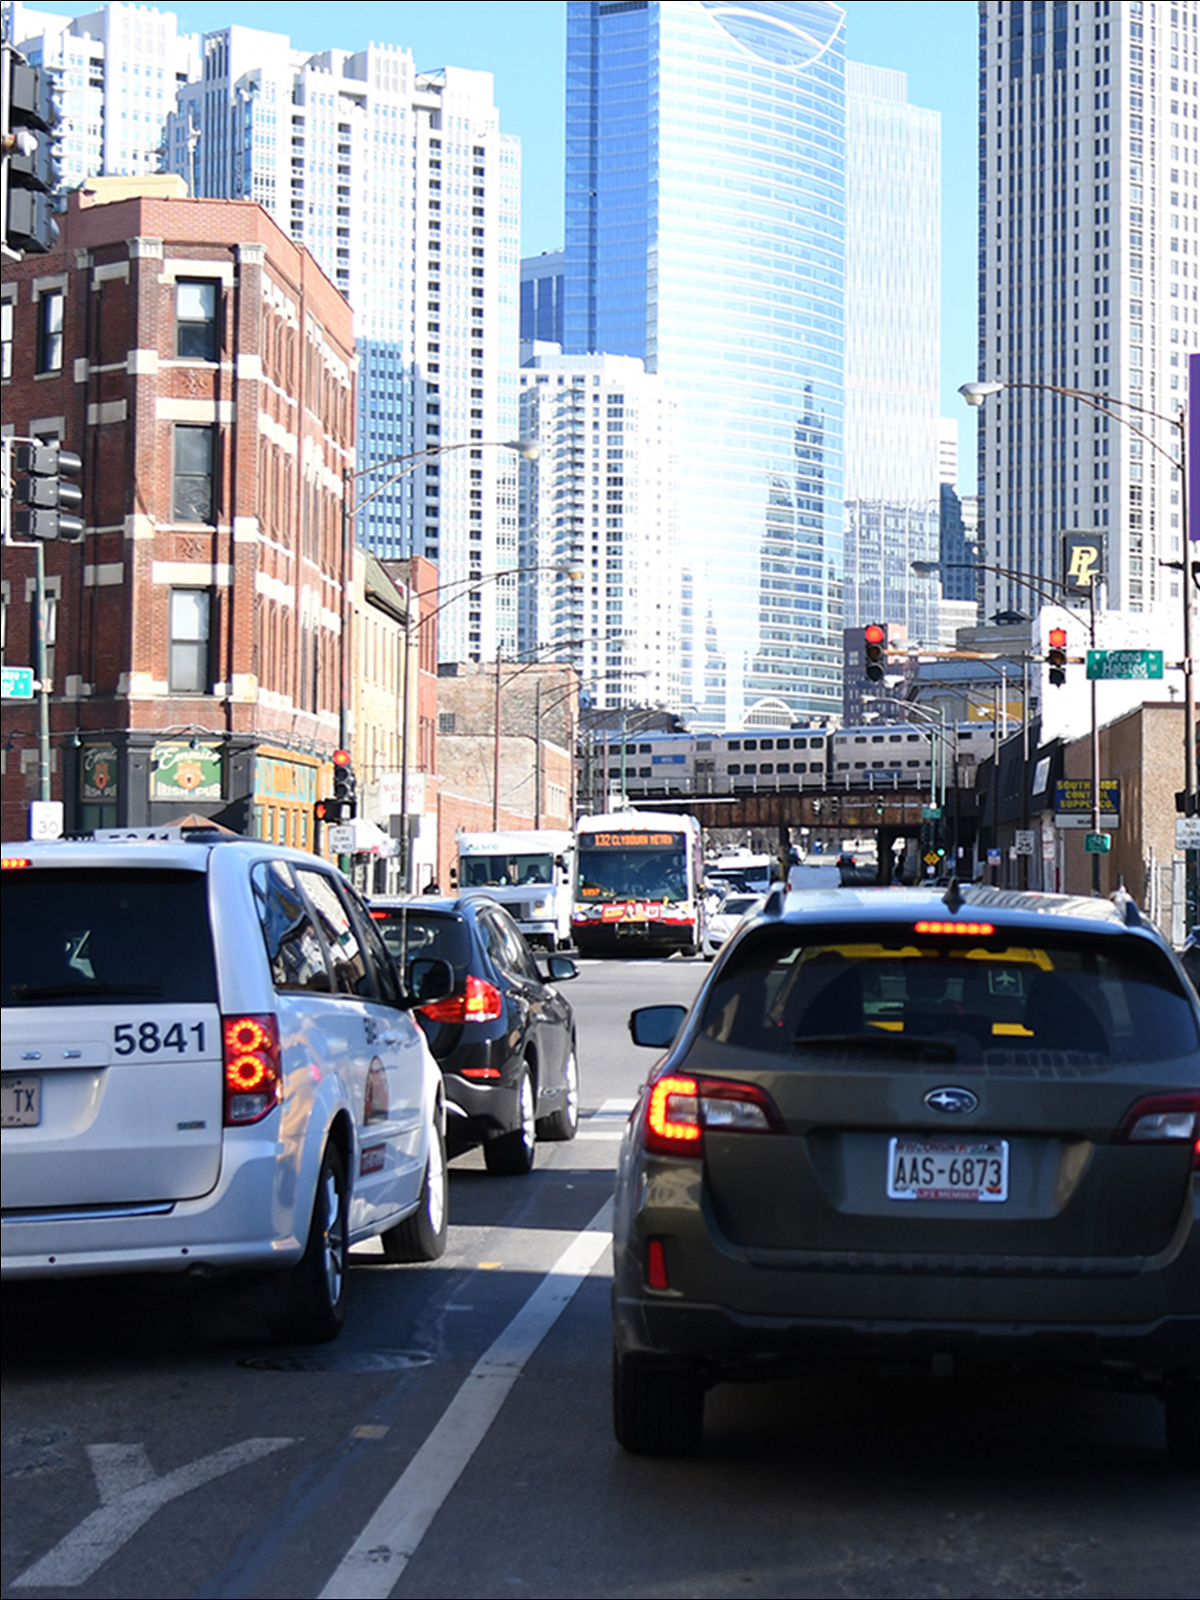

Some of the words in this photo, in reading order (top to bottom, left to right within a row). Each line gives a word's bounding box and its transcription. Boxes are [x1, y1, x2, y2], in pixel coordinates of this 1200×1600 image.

[1106, 650, 1142, 663] Grand
[1103, 662, 1148, 674] Halsted
[195, 782, 222, 797] PUB
[1057, 780, 1091, 791] SOUTH
[391, 793, 415, 803] BR
[1065, 791, 1109, 799] CONTOL
[37, 820, 59, 835] 30
[595, 833, 611, 847] 132
[113, 1021, 207, 1056] 5841
[14, 1088, 36, 1113] TX
[895, 1156, 1002, 1189] AAS-6873
